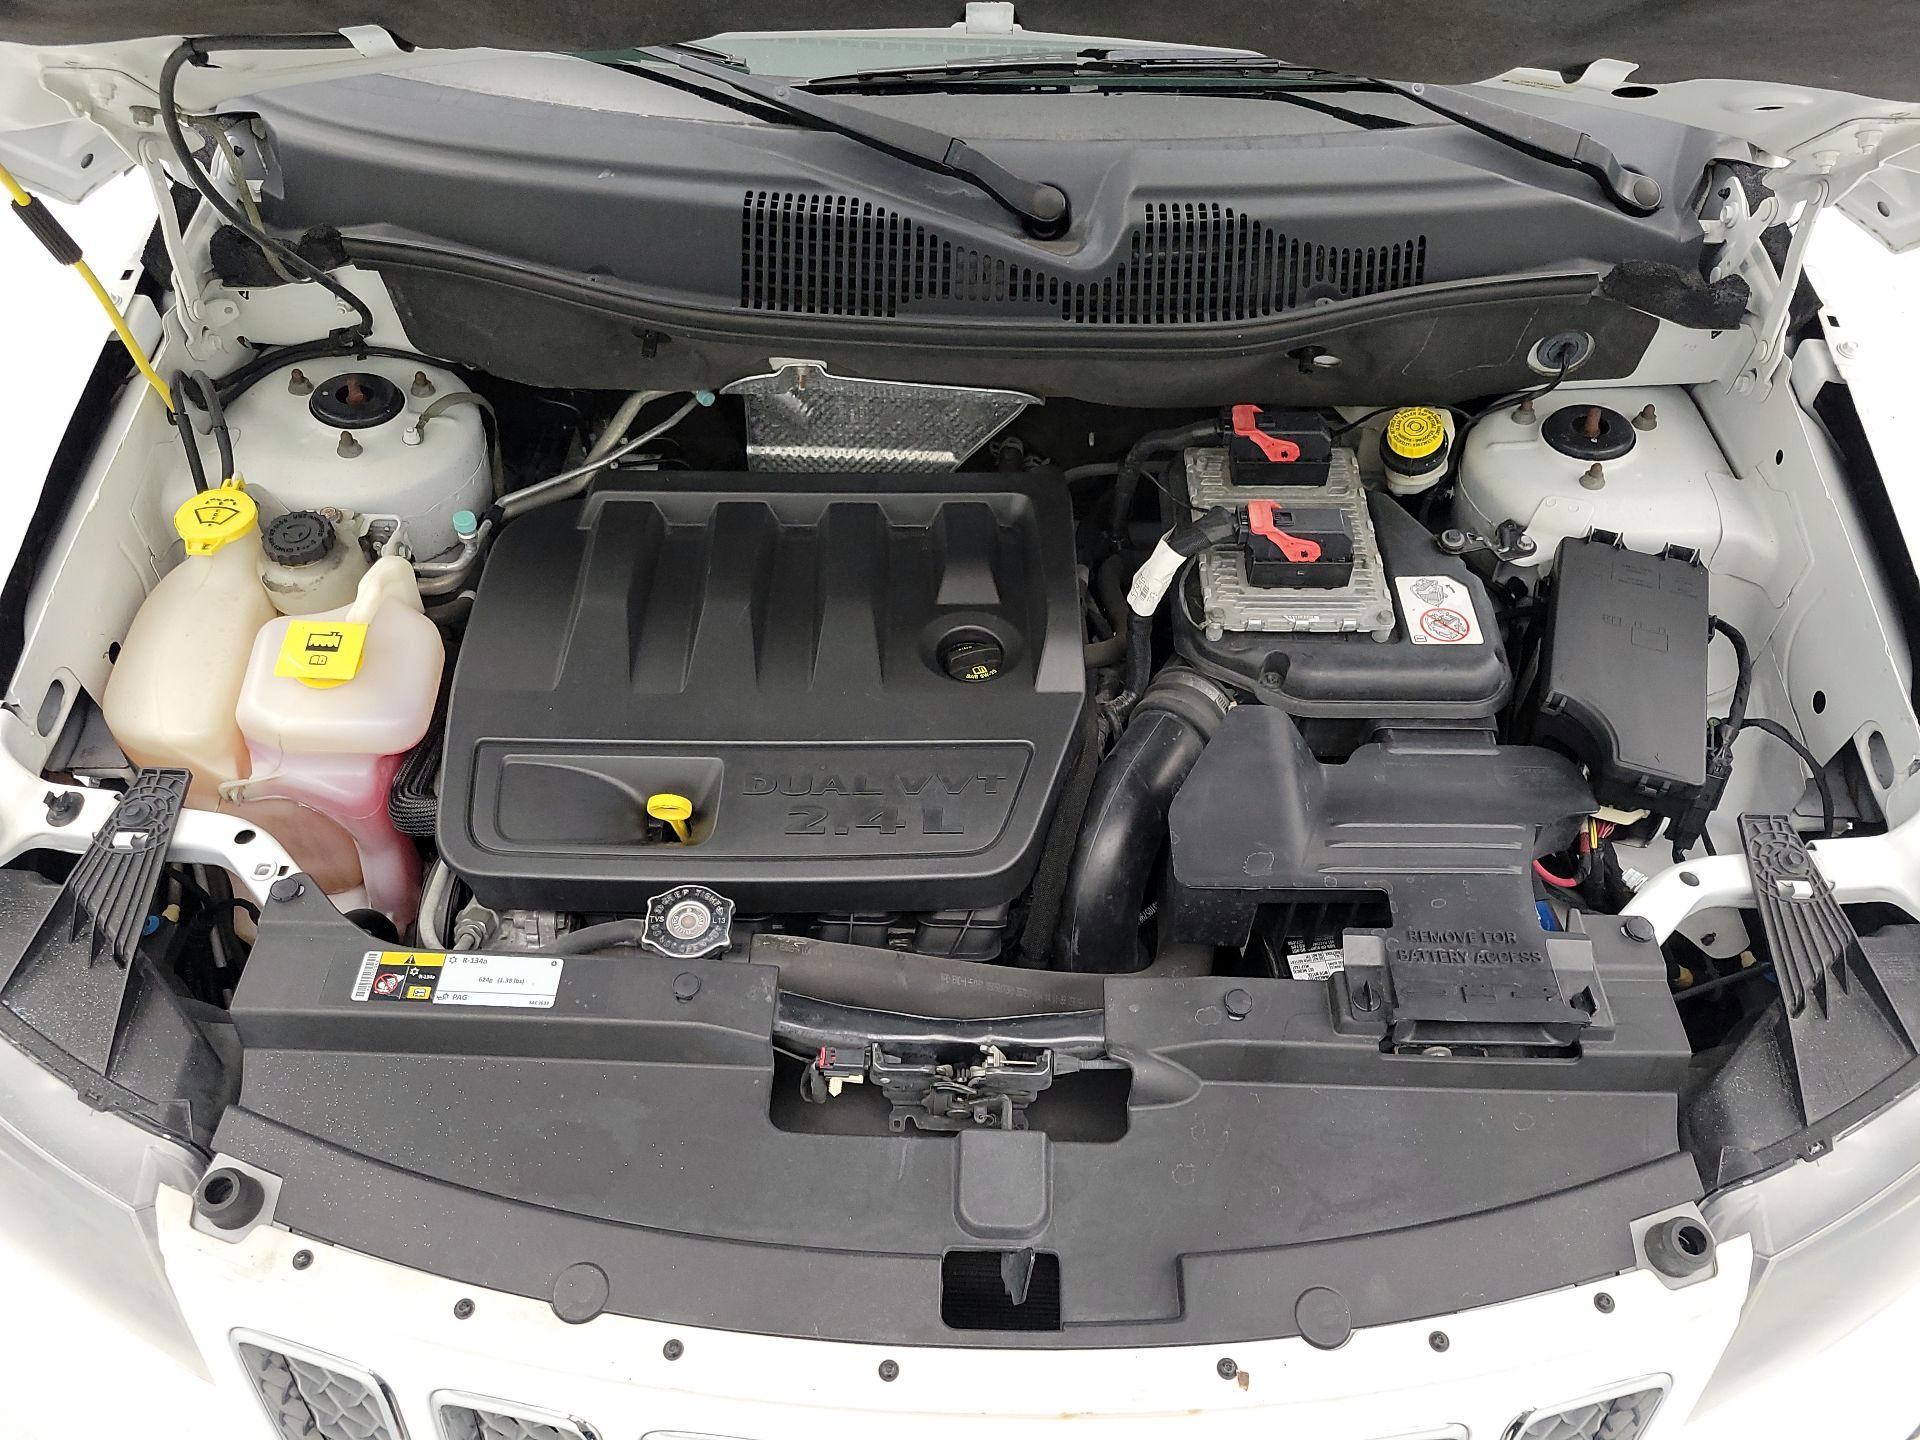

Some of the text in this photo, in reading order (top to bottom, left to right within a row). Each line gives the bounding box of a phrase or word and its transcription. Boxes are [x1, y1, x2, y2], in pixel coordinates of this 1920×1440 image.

[742, 773, 1007, 796] DUAL VVT
[649, 915, 665, 924] TVS
[1407, 928, 1518, 945] REMOVE FOR
[1396, 947, 1544, 964] BATTERY ACCESS
[462, 956, 489, 966] R-134a
[478, 976, 493, 985] 624g
[451, 993, 469, 1002] PAG
